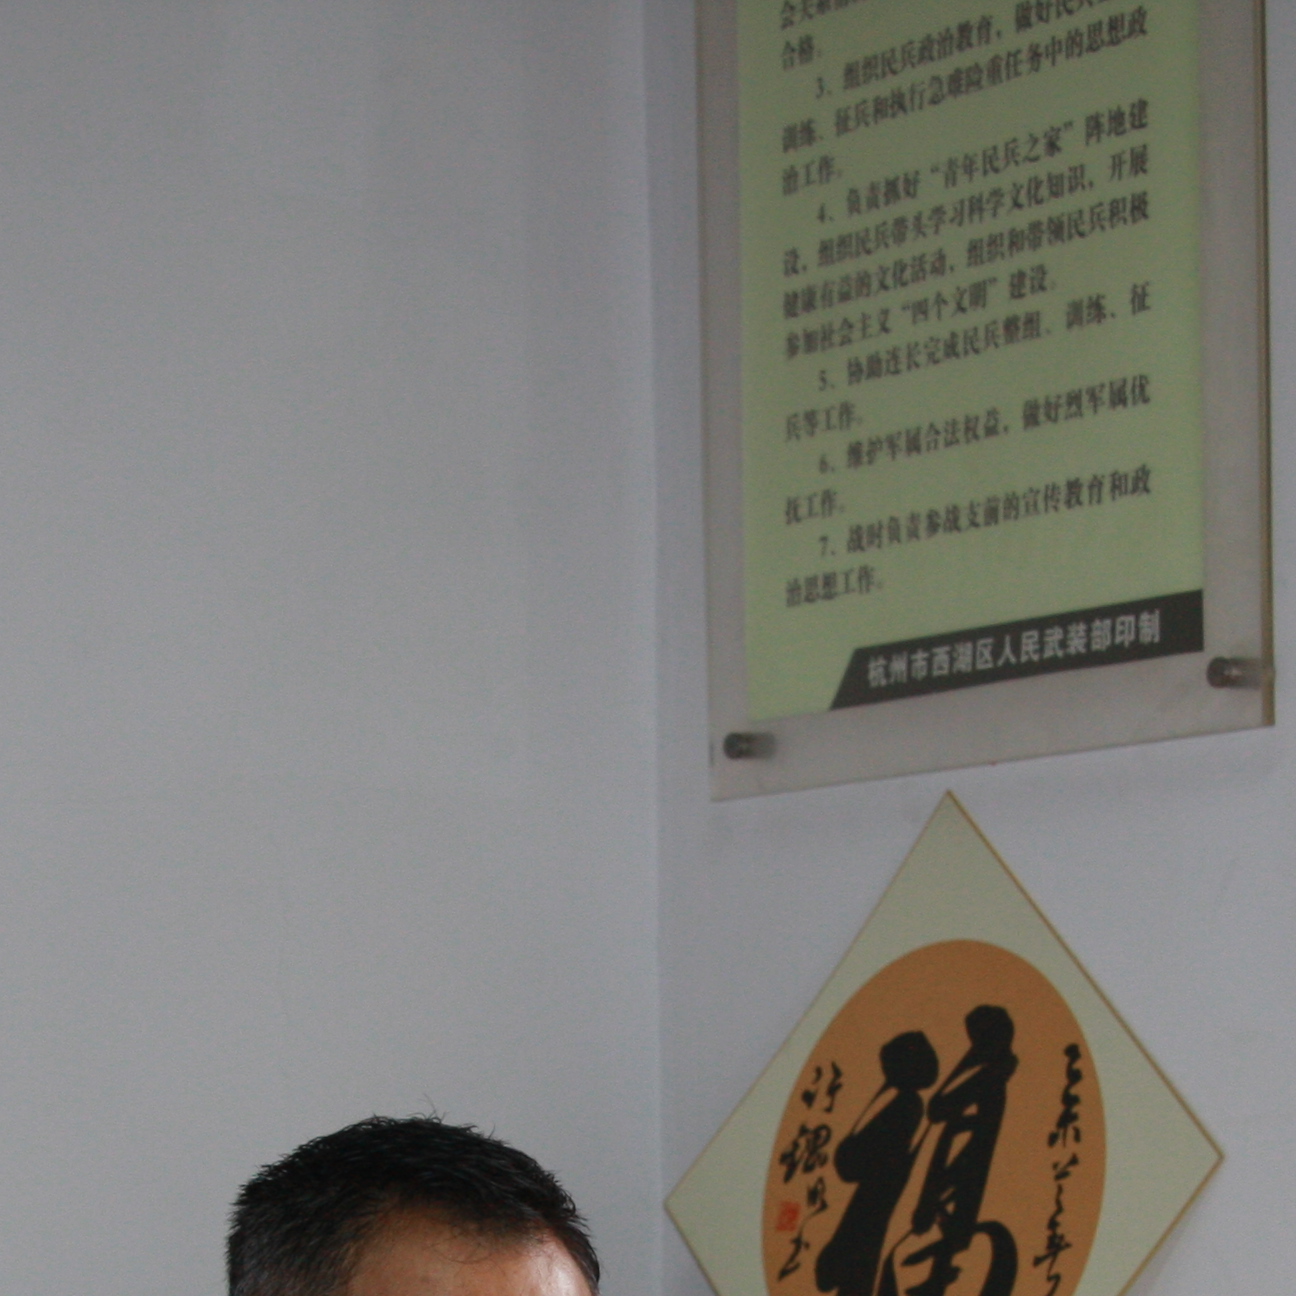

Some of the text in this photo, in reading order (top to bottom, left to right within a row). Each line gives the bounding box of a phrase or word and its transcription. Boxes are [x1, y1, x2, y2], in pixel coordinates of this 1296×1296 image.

[867, 609, 1162, 690] 杭州市西湖区人民武装部印制
